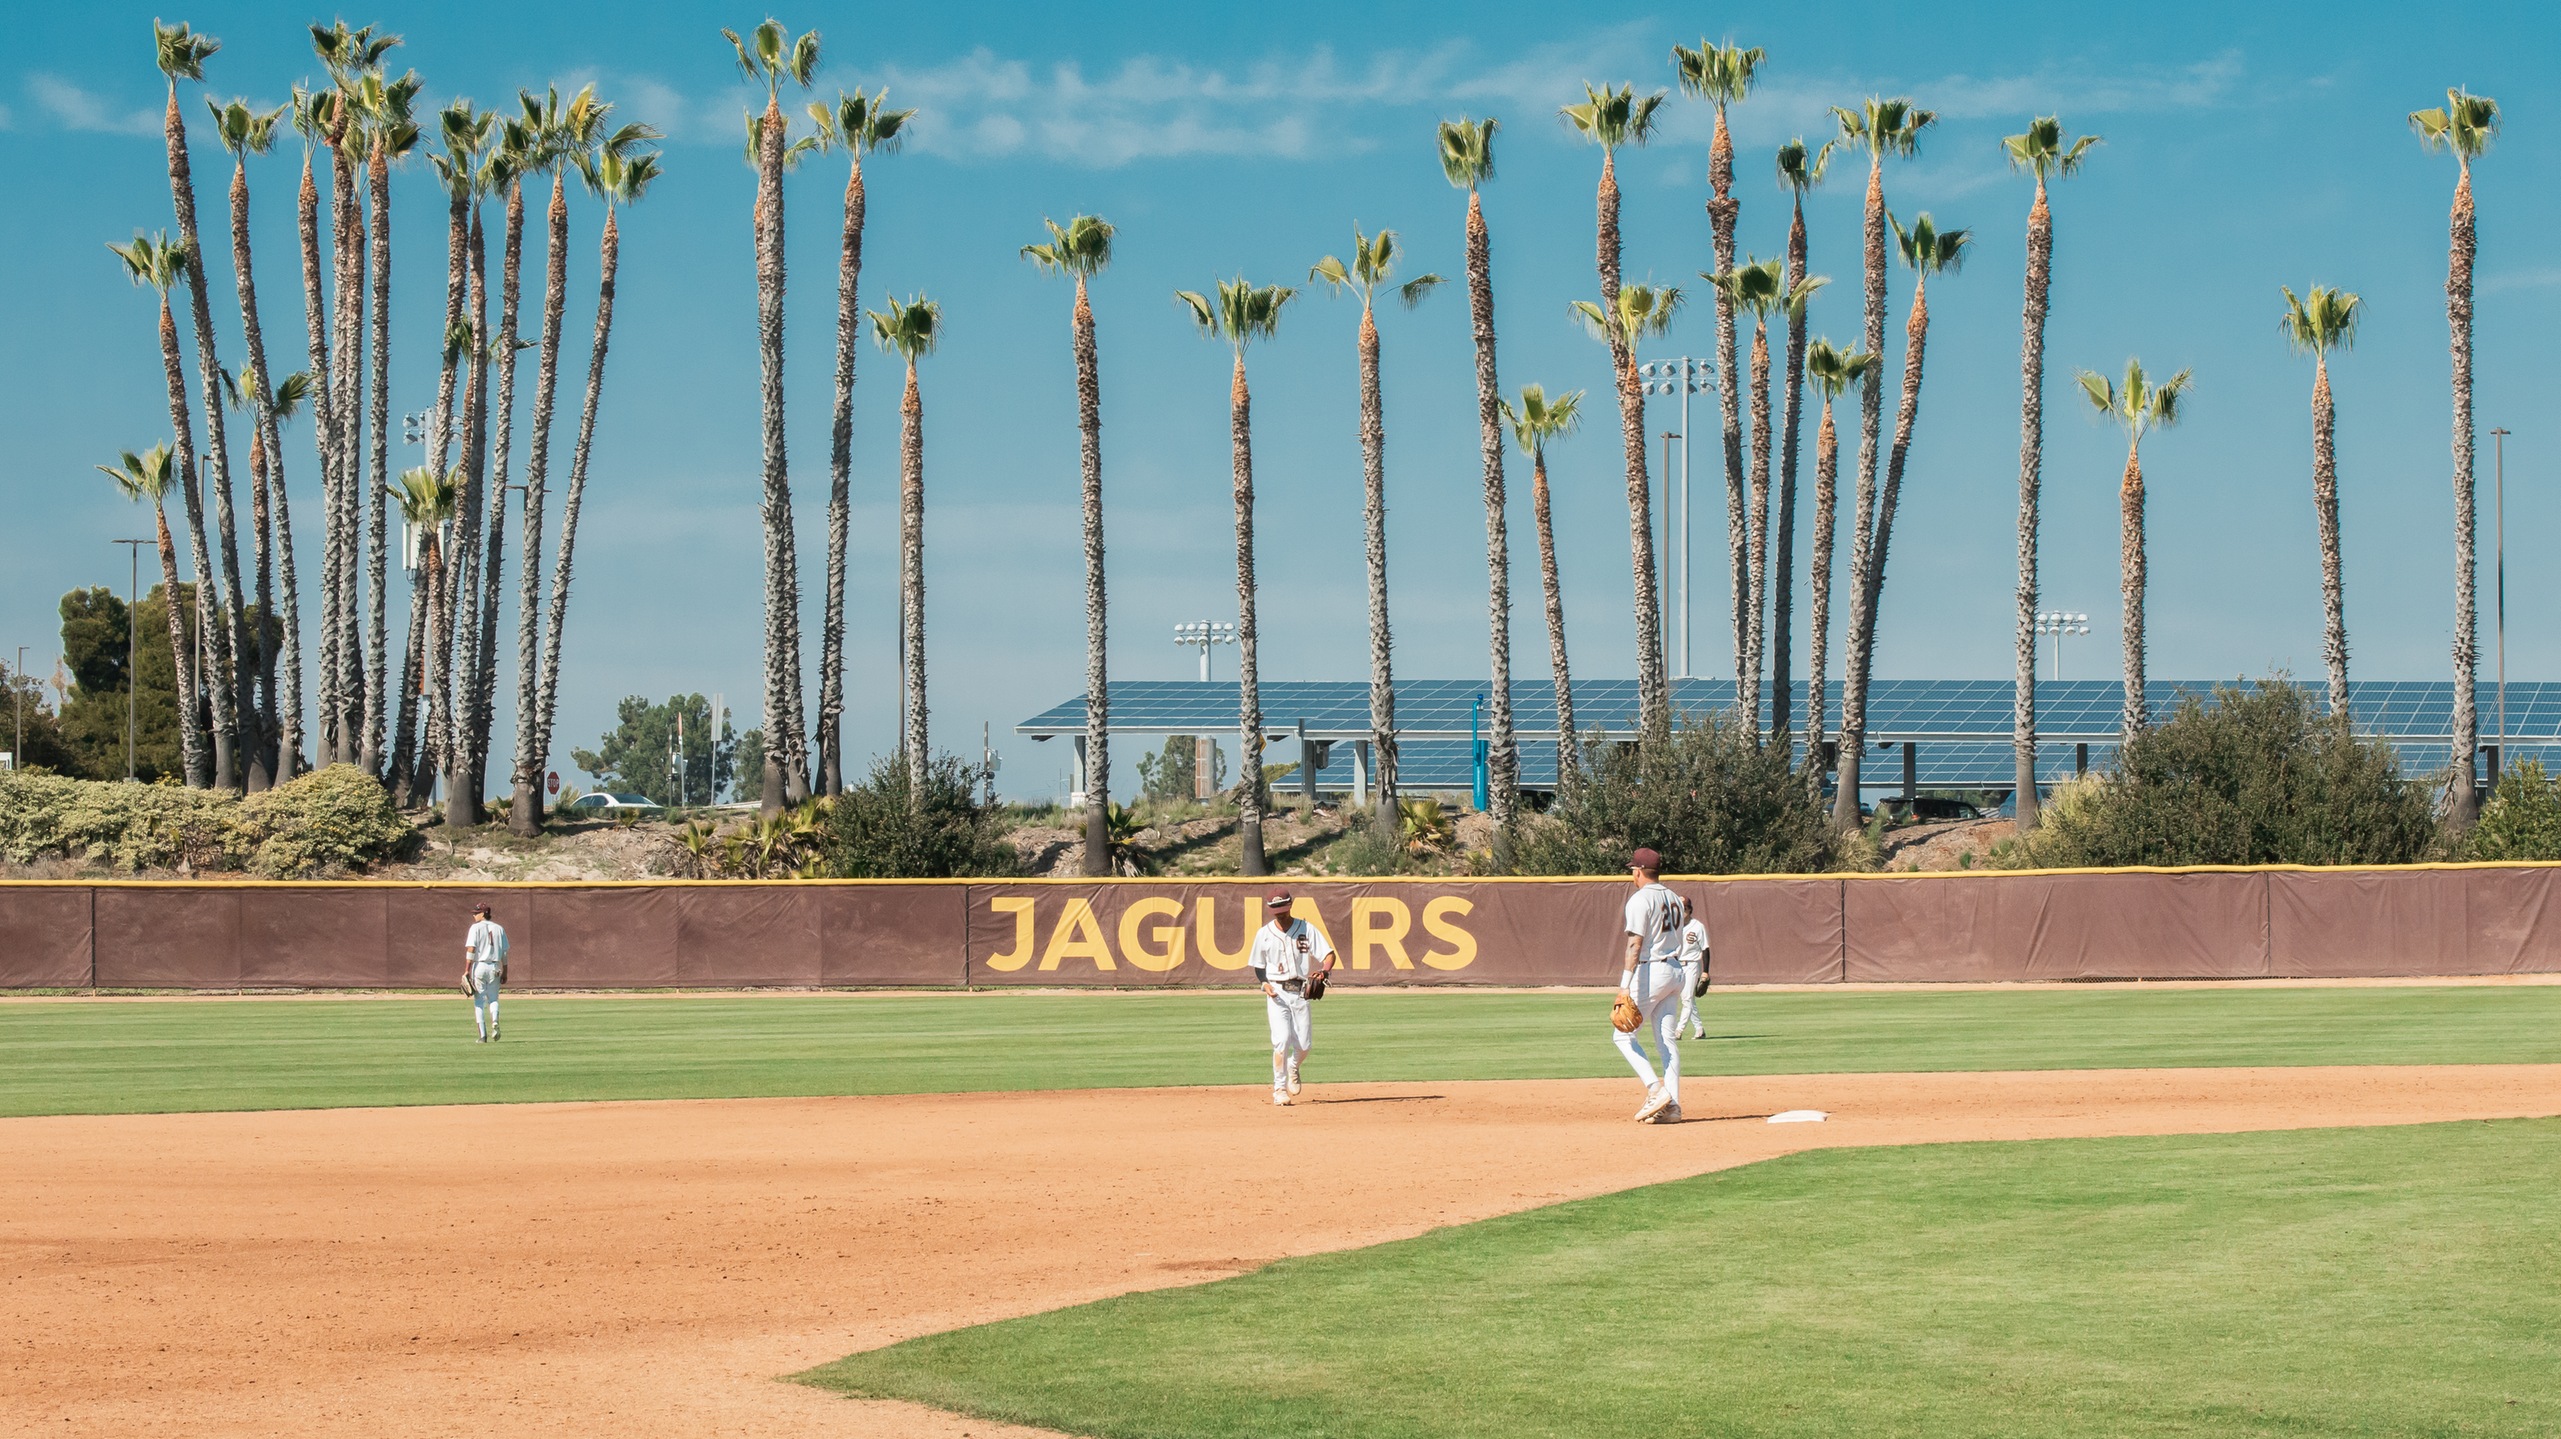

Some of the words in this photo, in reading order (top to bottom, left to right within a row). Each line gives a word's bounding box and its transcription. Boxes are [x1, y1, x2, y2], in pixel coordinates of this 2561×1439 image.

[547, 778, 559, 787] STOP
[1661, 902, 1680, 932] 20
[488, 930, 494, 946] 1
[986, 896, 1477, 972] JAGUARS
